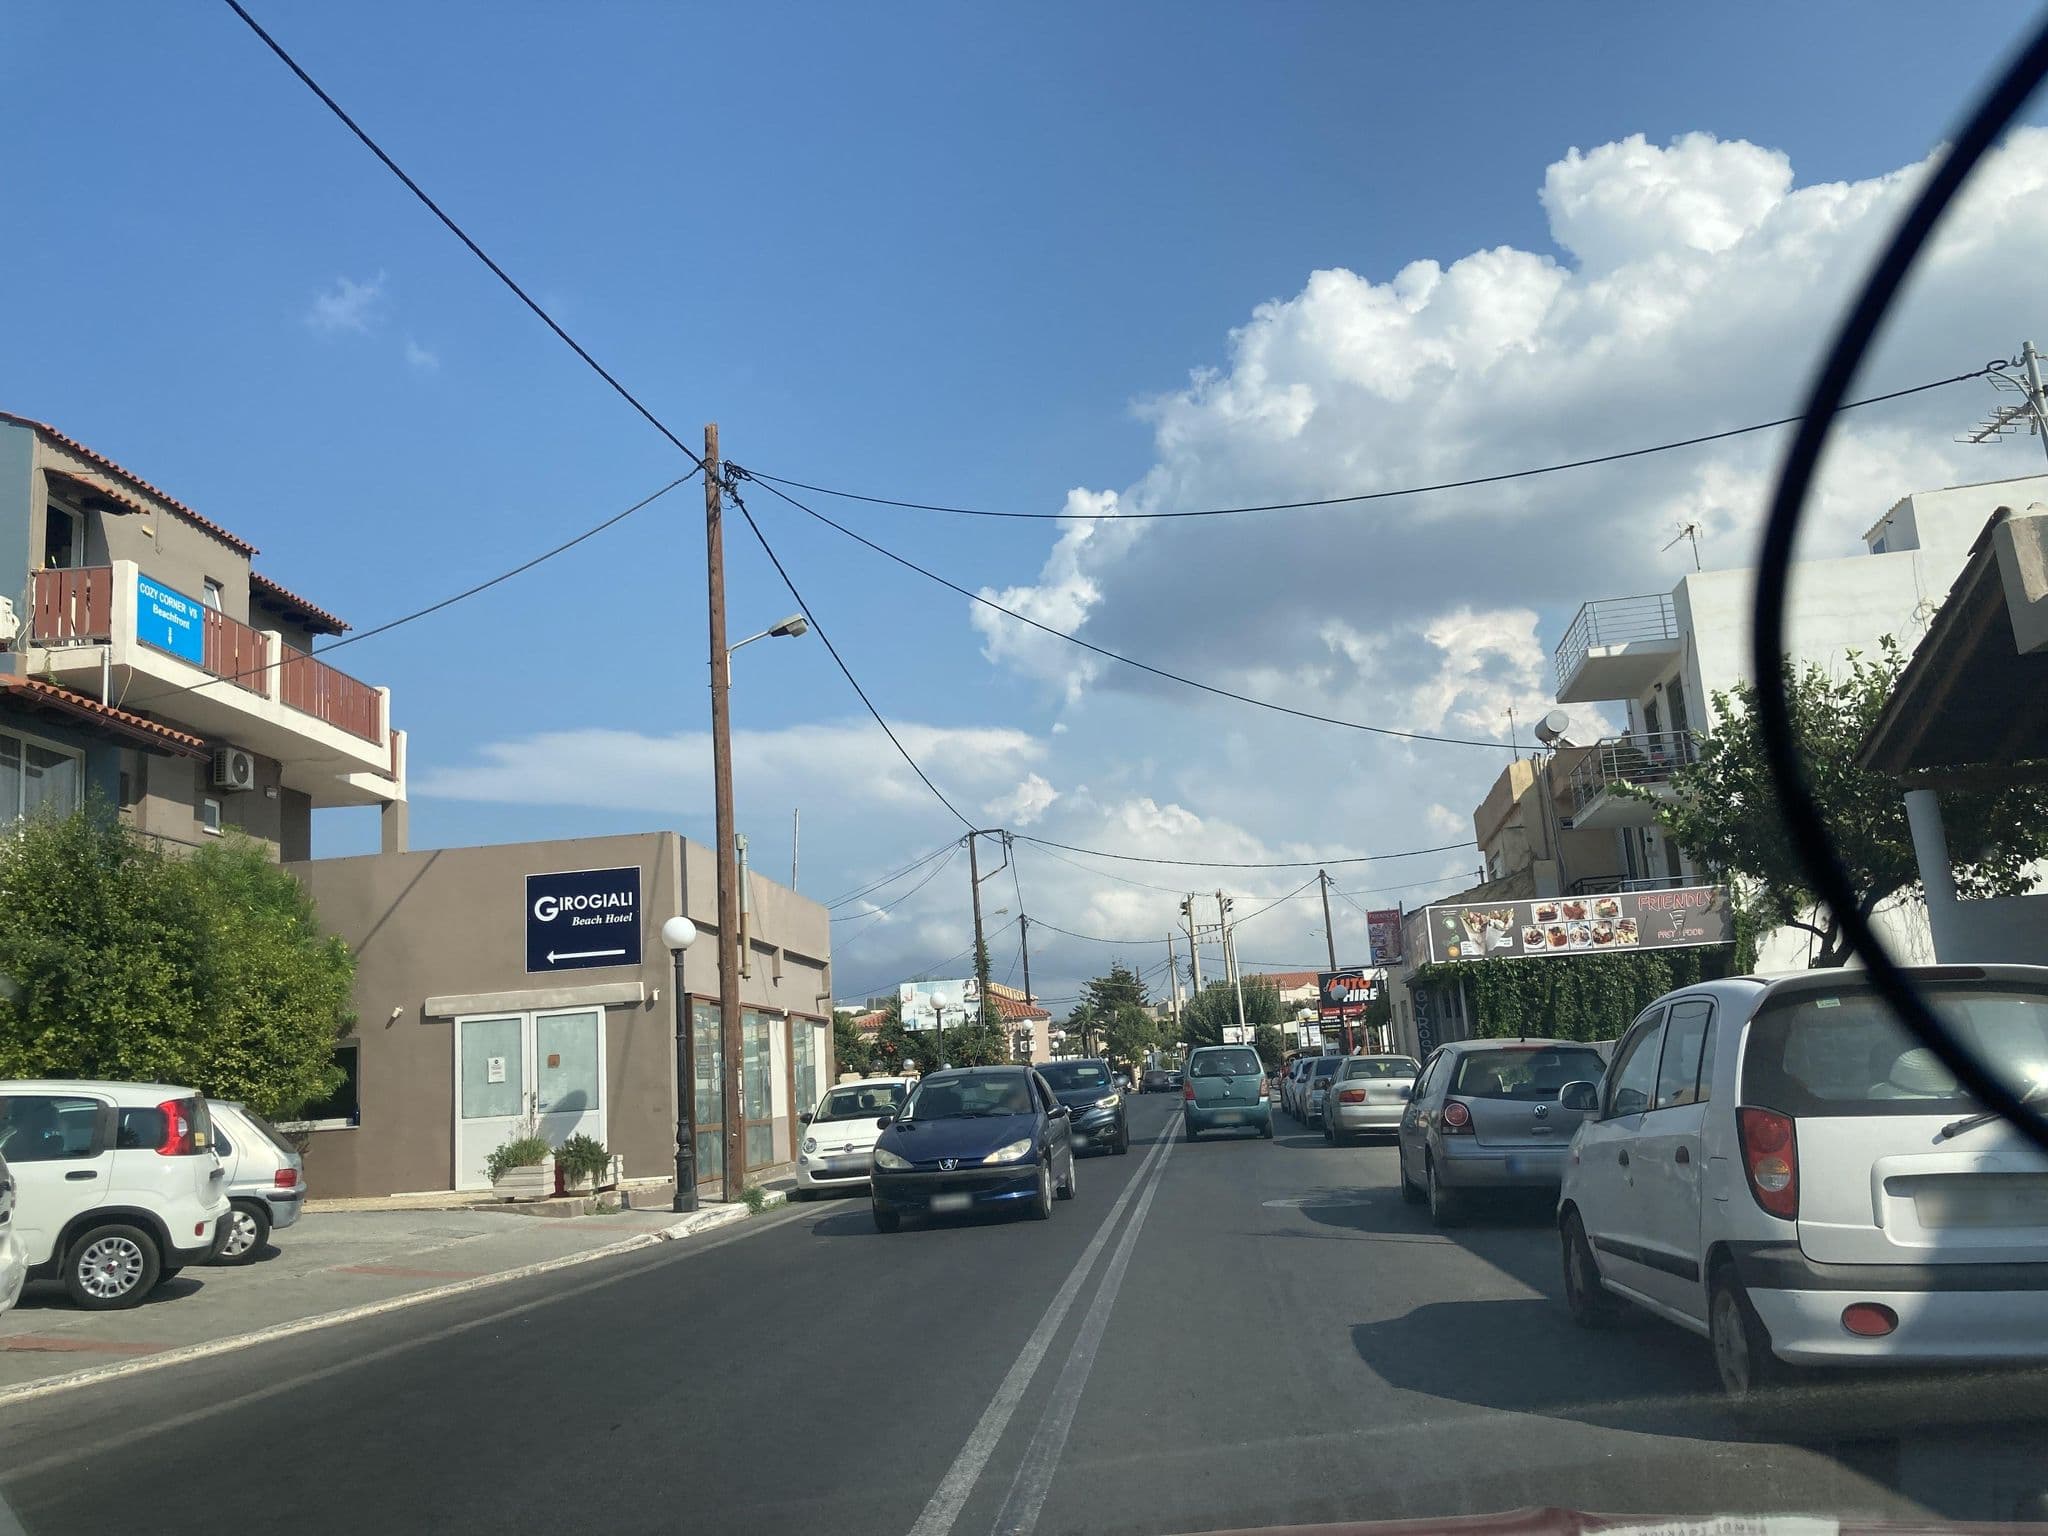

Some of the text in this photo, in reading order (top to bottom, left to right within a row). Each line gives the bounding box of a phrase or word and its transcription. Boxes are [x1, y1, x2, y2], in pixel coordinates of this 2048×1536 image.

[140, 583, 158, 599] COZY
[160, 593, 186, 613] CORNER
[153, 603, 190, 629] Beachfront
[534, 891, 632, 921] GIROGIALI
[572, 912, 632, 926] Beach Hotel
[1328, 978, 1371, 992] AUTO
[1343, 988, 1378, 1002] HIRE
